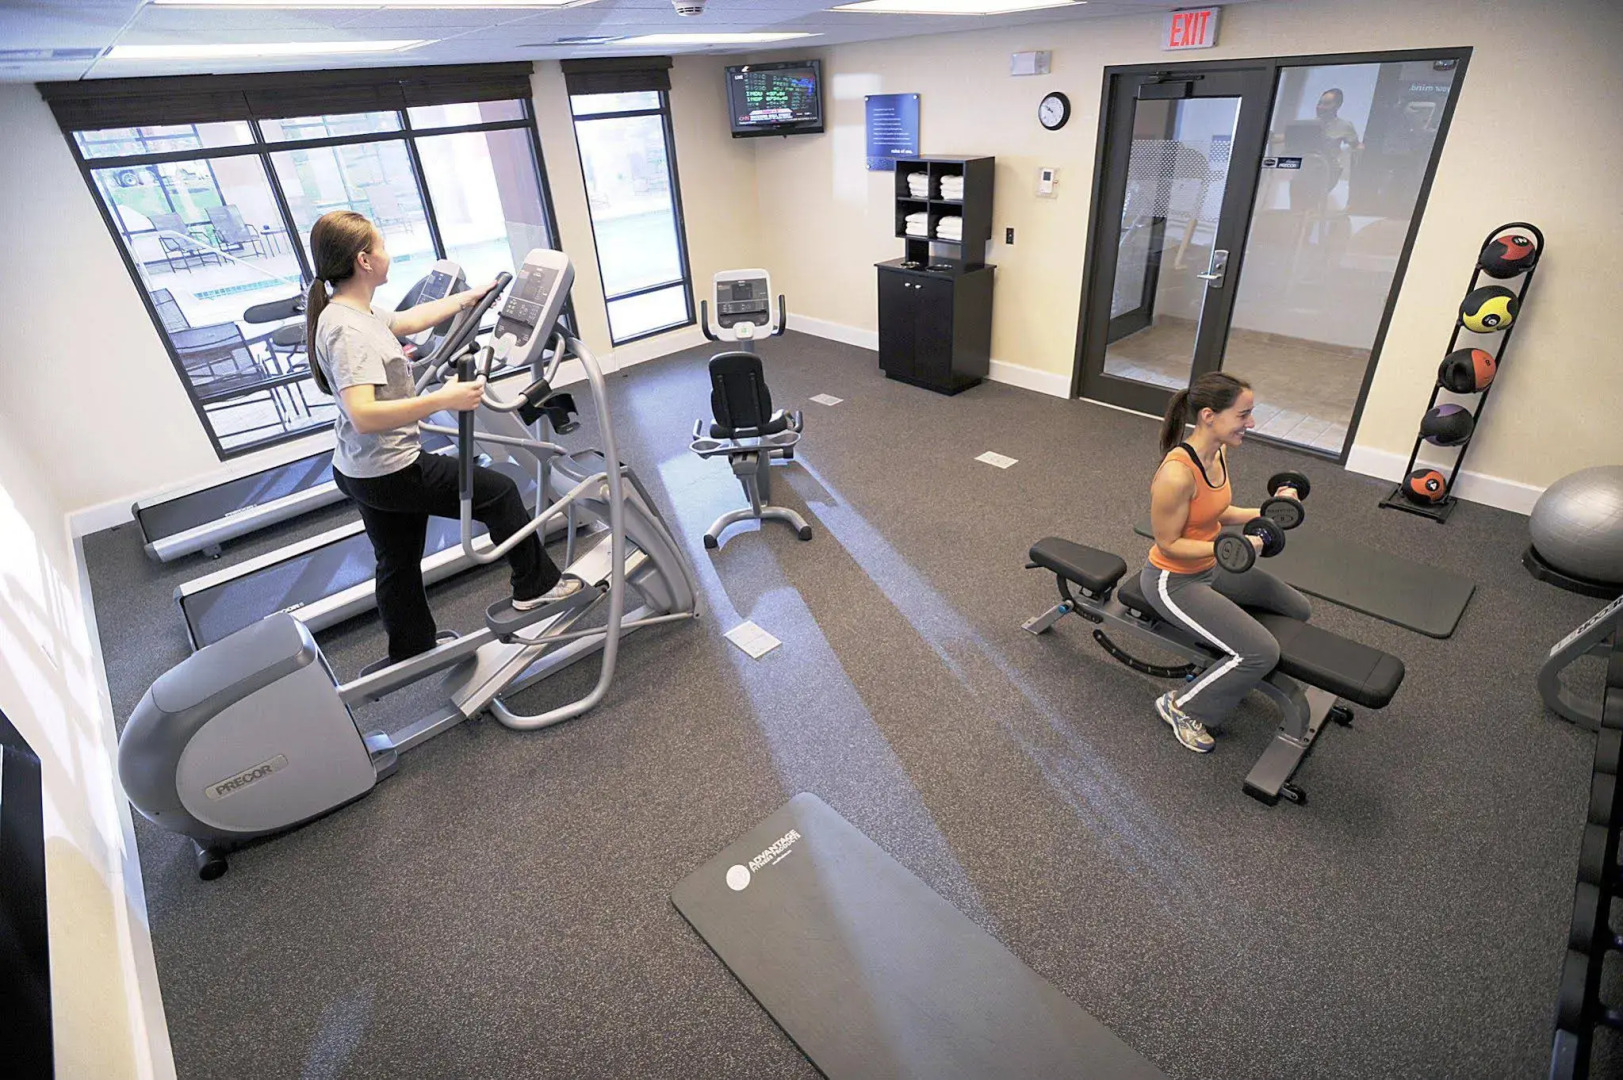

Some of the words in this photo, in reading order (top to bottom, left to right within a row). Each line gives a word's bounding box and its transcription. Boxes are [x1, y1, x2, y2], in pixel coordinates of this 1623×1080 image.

[1169, 11, 1211, 46] EXIT
[215, 764, 273, 796] PRECOR
[747, 828, 798, 870] ADVANTAGE
[752, 855, 773, 874] FITNESS
[772, 833, 801, 857] PRODUCTS
